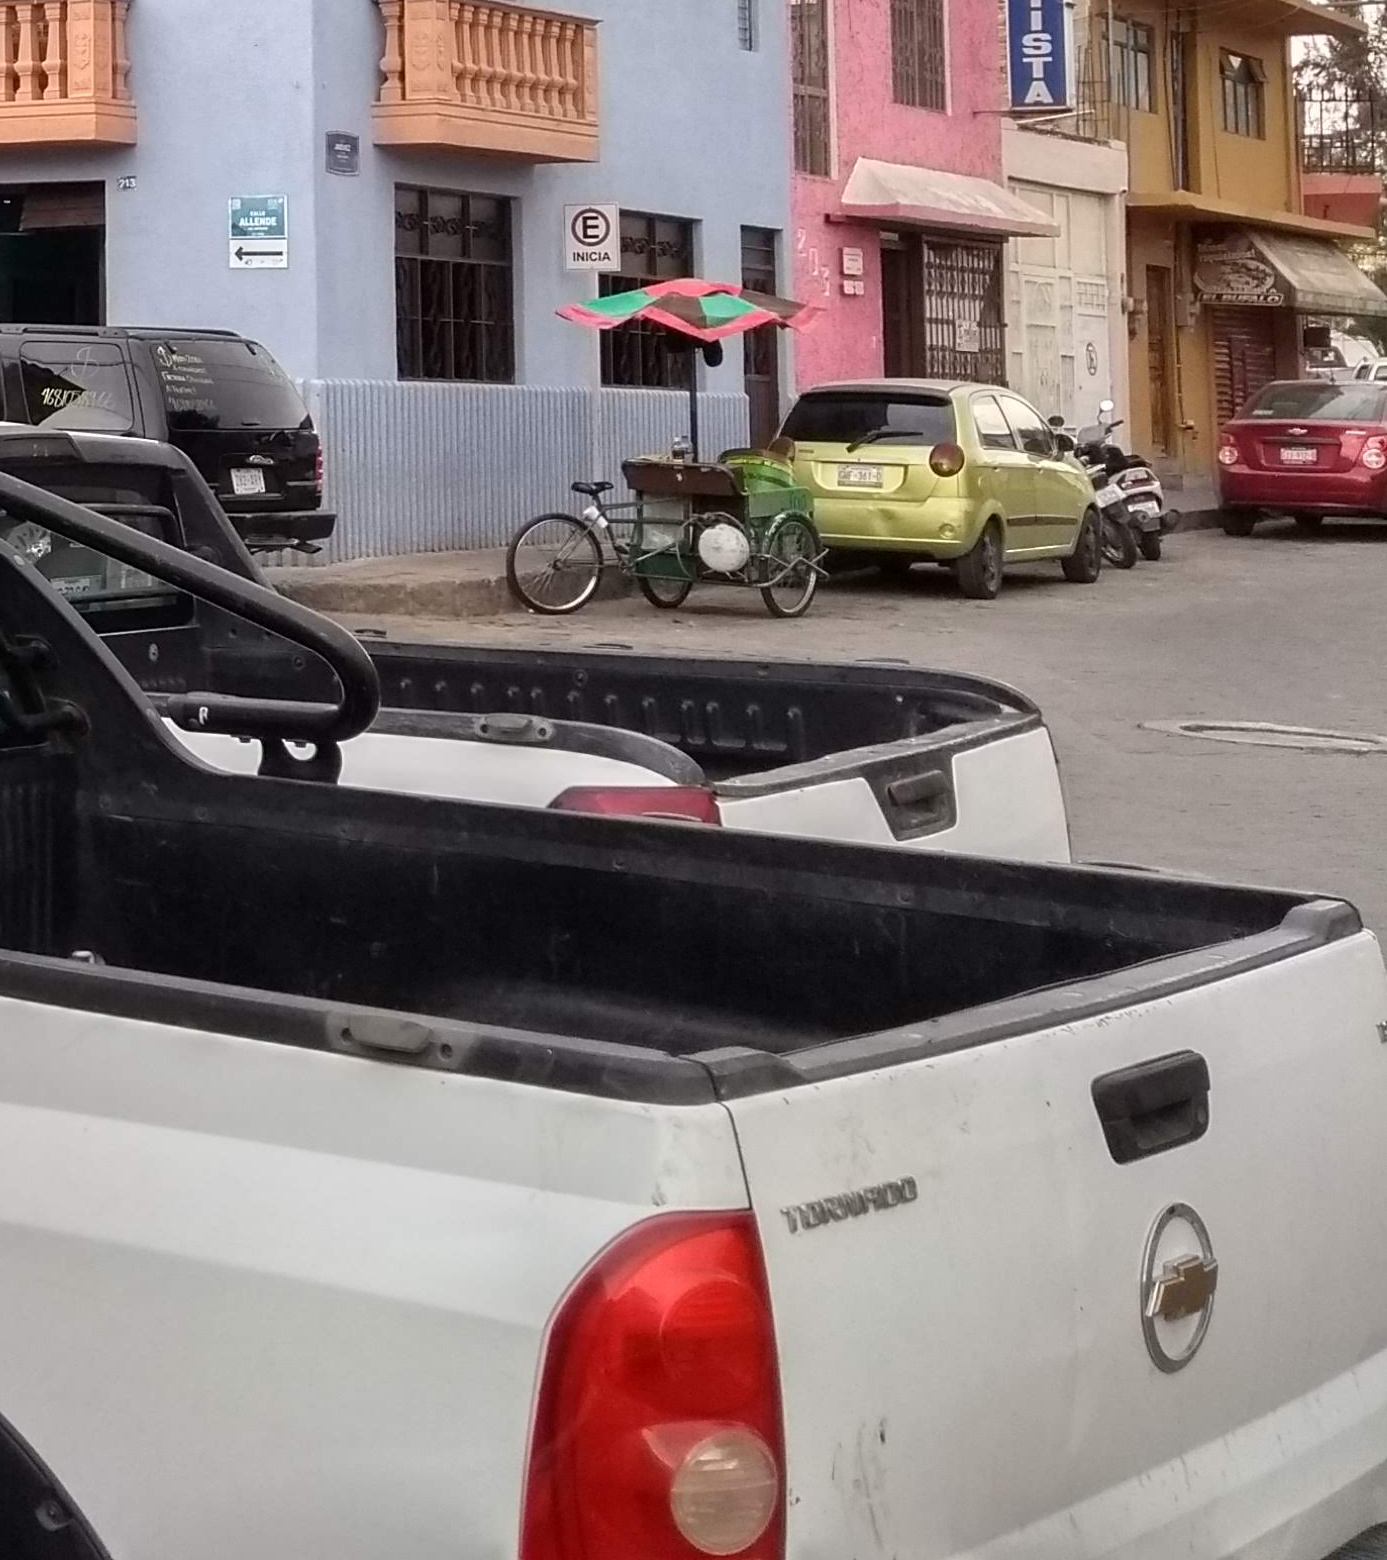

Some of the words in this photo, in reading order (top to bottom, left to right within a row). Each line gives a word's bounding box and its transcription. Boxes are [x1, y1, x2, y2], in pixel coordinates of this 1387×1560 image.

[239, 216, 278, 227] ALLENDE
[572, 251, 611, 262] INICIA
[779, 1175, 918, 1234] TORNADO
